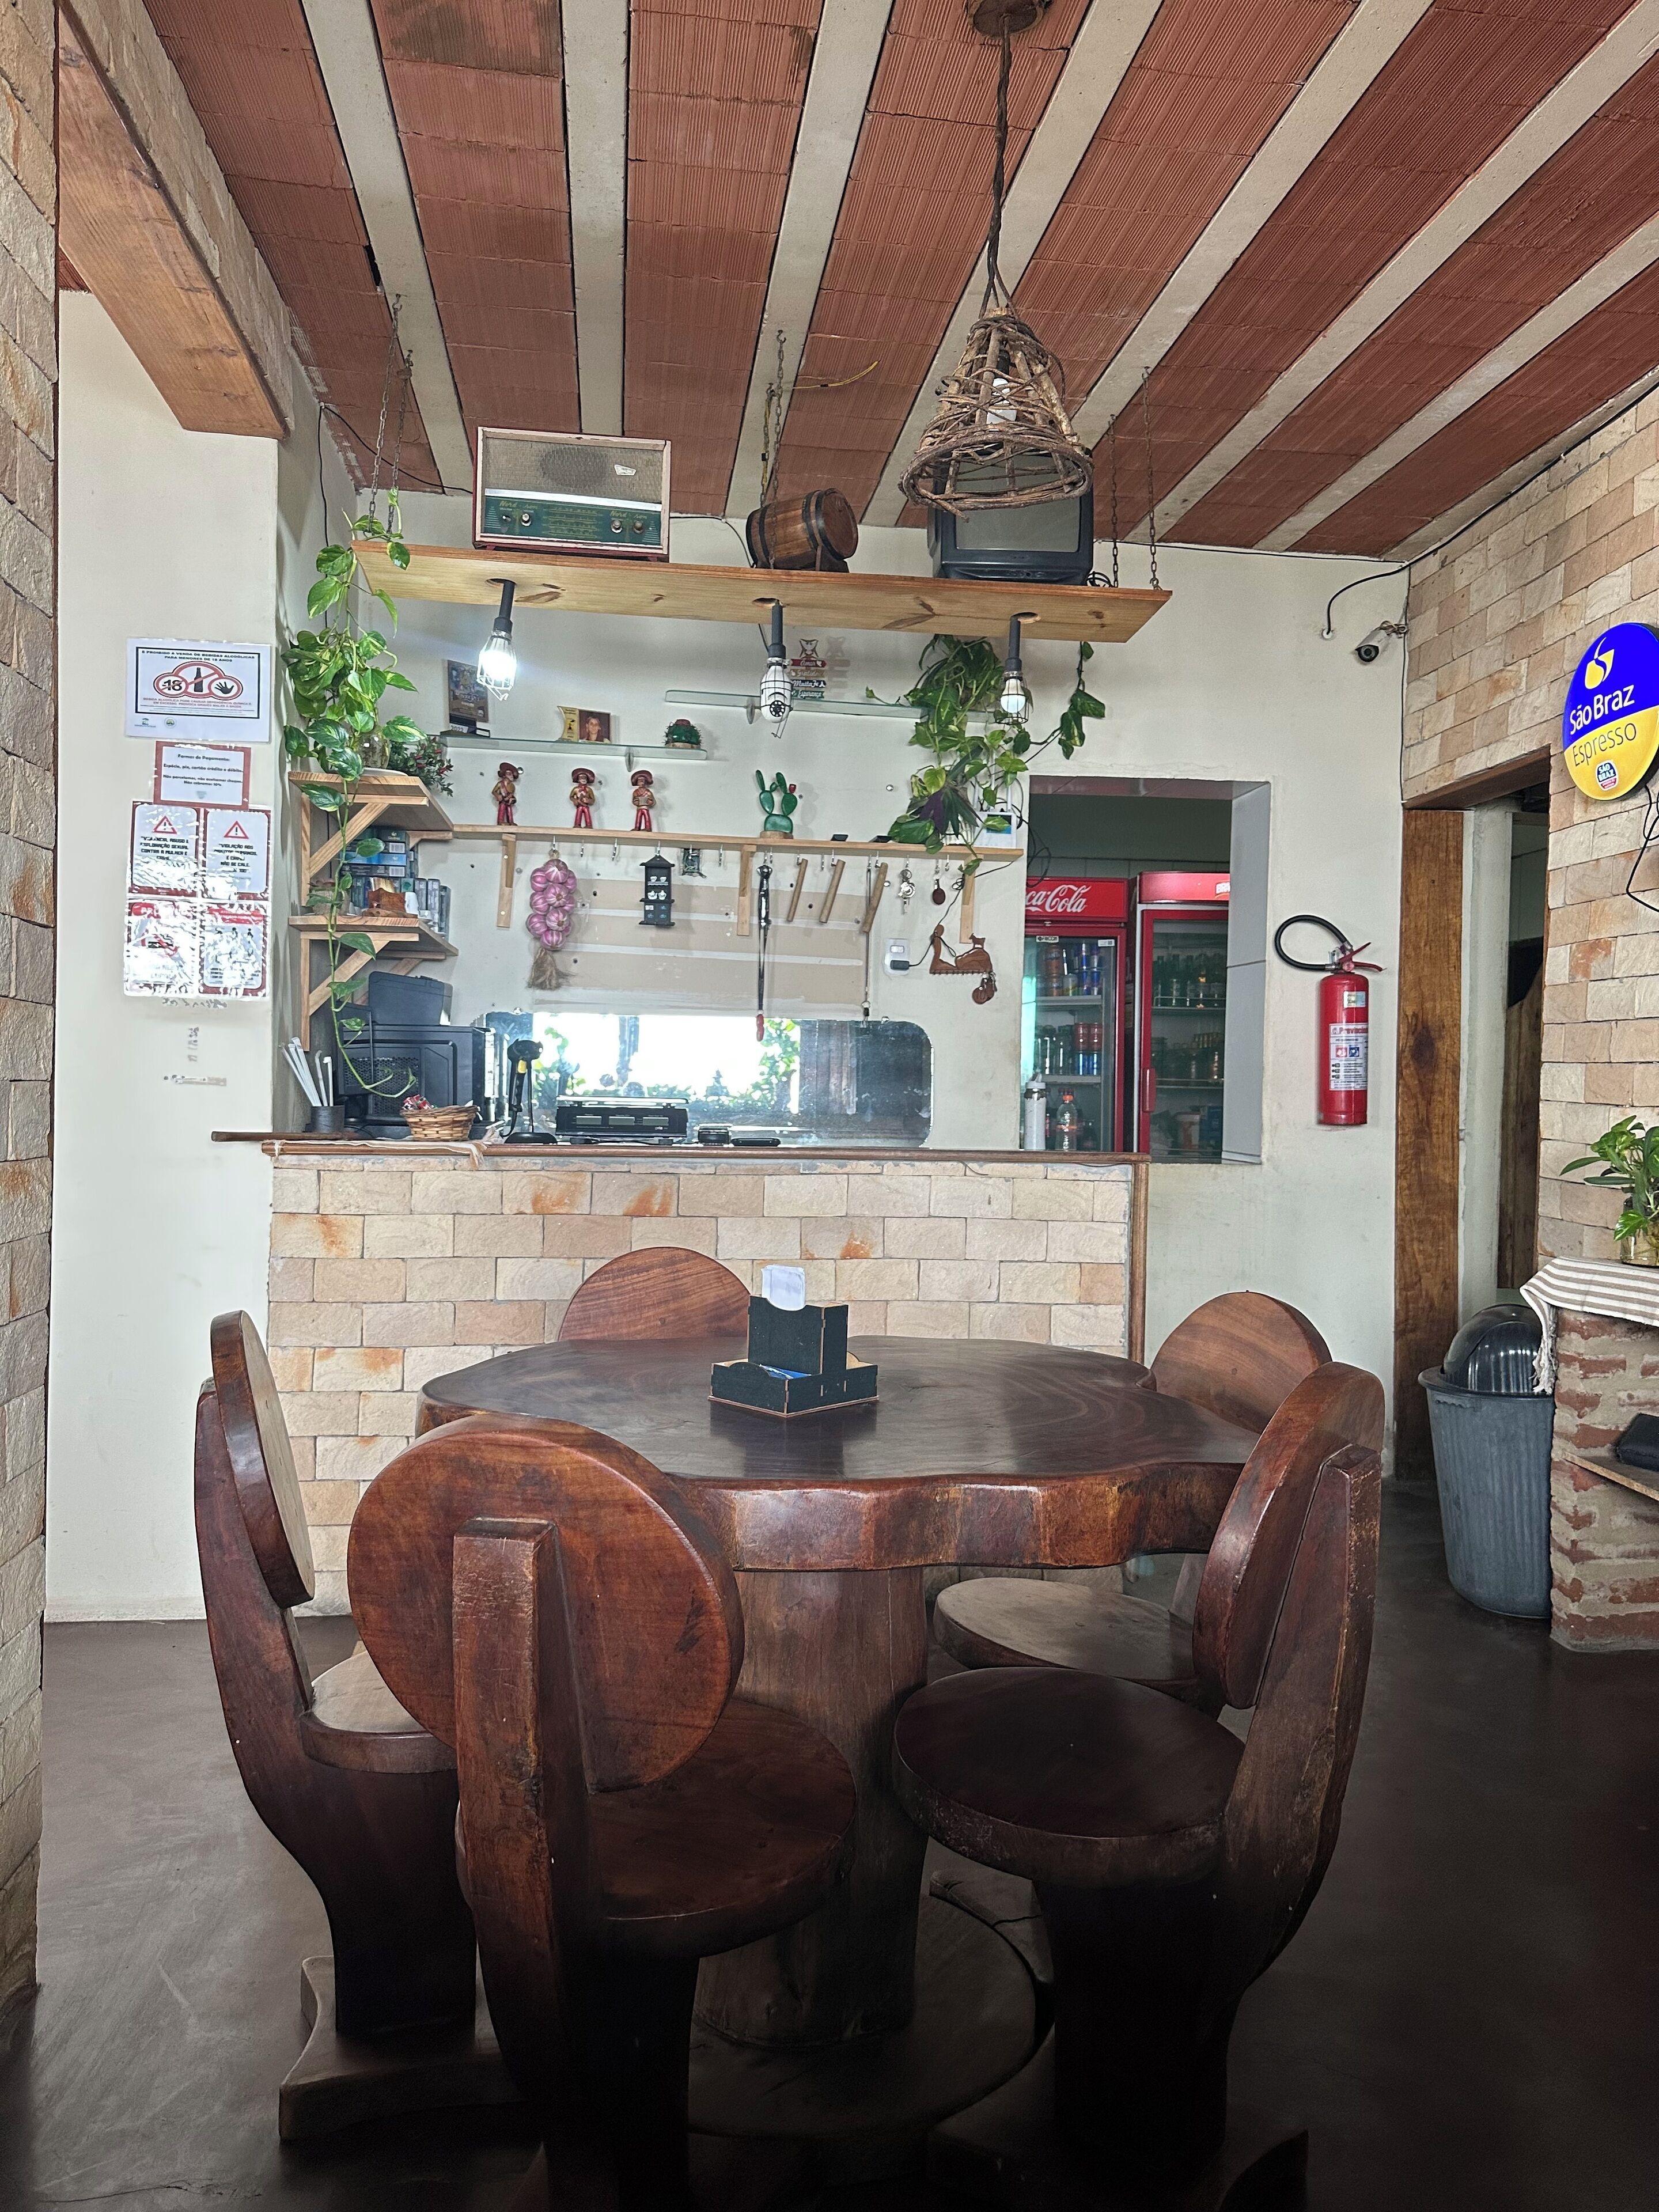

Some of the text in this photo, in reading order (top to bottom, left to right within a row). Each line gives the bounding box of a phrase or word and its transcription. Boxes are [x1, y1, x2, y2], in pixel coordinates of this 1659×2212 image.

[1569, 684, 1635, 736] São Braz
[1573, 722, 1637, 767] Espresso
[1025, 884, 1092, 912] ca-Cola
